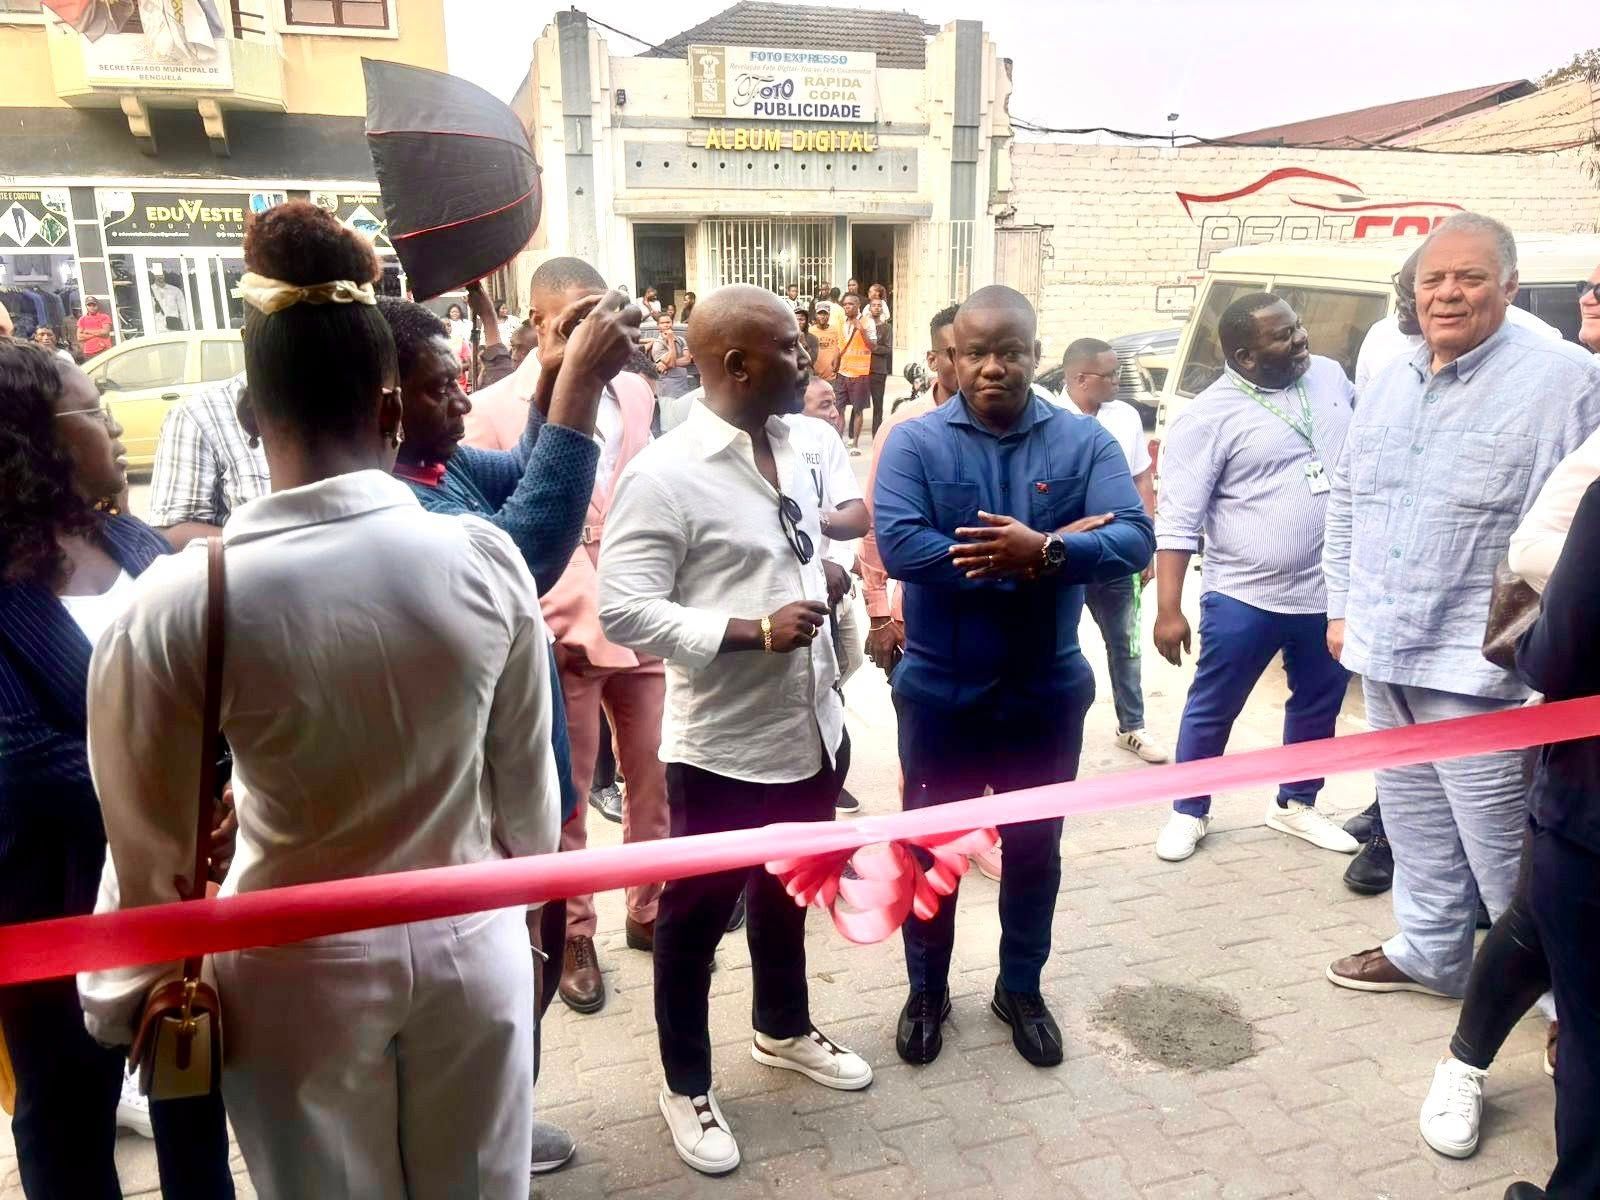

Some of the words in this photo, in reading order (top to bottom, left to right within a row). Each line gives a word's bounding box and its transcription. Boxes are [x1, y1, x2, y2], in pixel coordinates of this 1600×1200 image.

[750, 51, 782, 62] FOTO
[784, 53, 848, 65] EXPRESSO
[99, 64, 161, 72] SECRETARIADO
[162, 66, 206, 74] MUNICIPAL
[753, 102, 861, 119] PUBLICIDADE
[705, 128, 781, 151] ALBUM
[792, 131, 873, 152] DIGITAL
[145, 199, 243, 222] EDUVESTE
[132, 223, 243, 231] BOUTIQU
